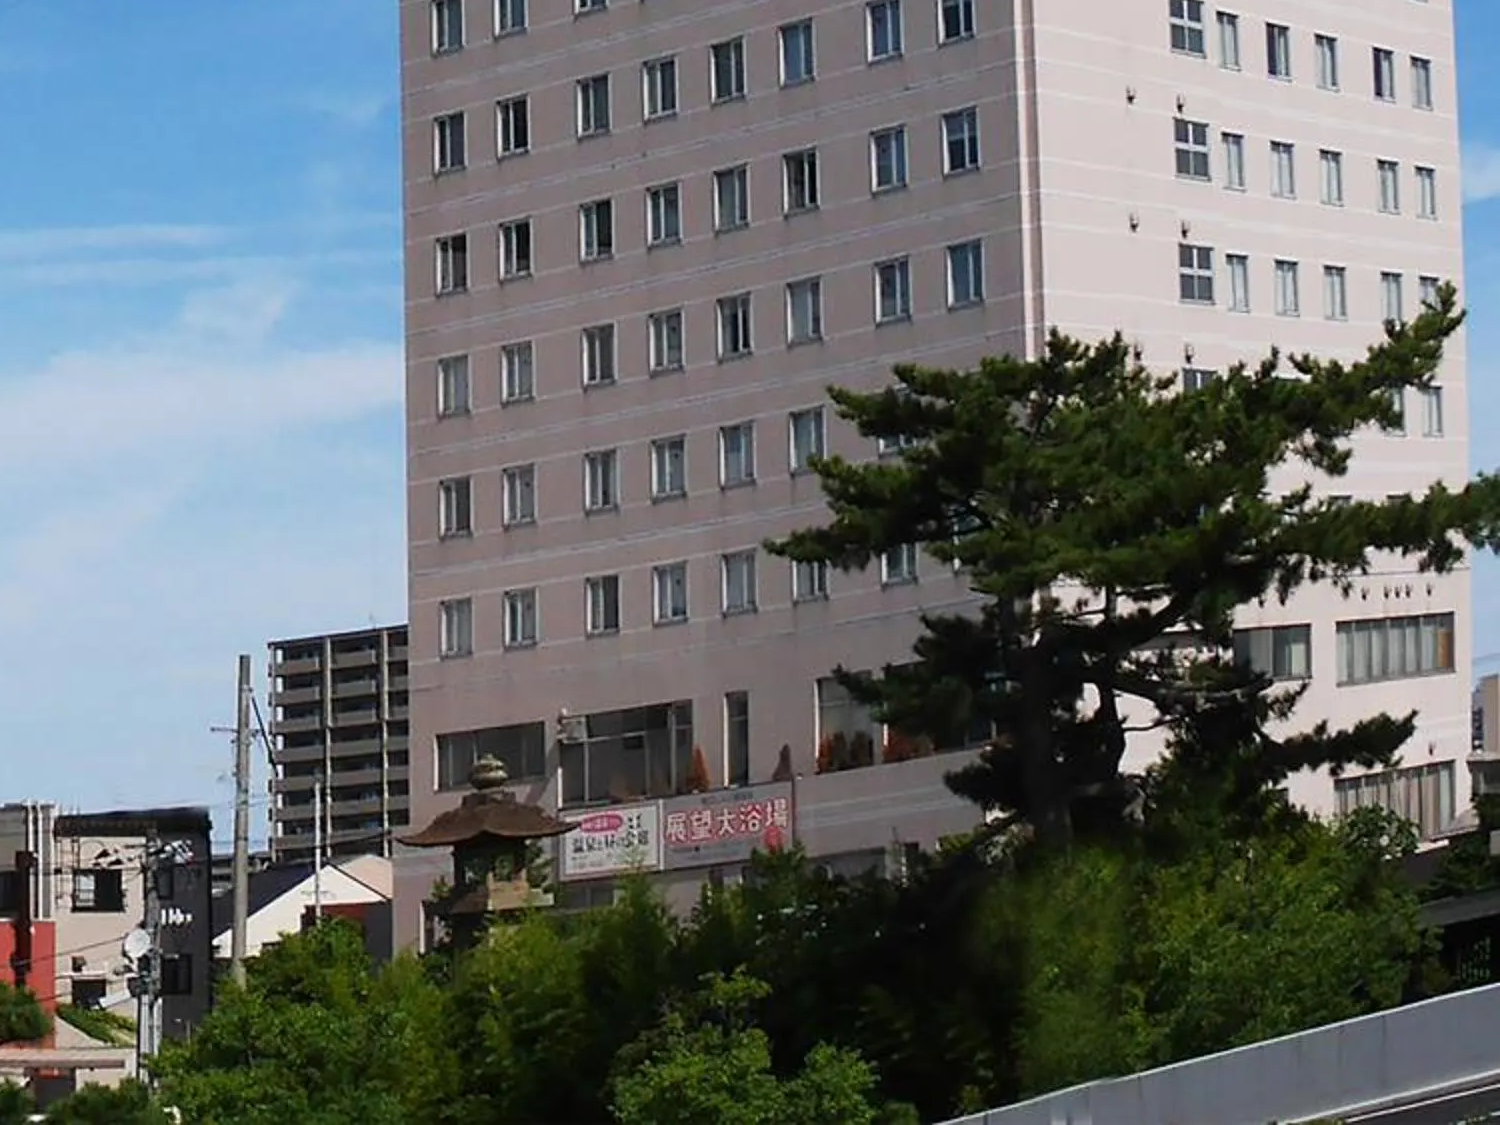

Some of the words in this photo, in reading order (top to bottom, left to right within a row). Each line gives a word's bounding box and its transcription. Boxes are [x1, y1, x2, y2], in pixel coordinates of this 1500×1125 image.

[666, 798, 788, 844] 展望大浴場
